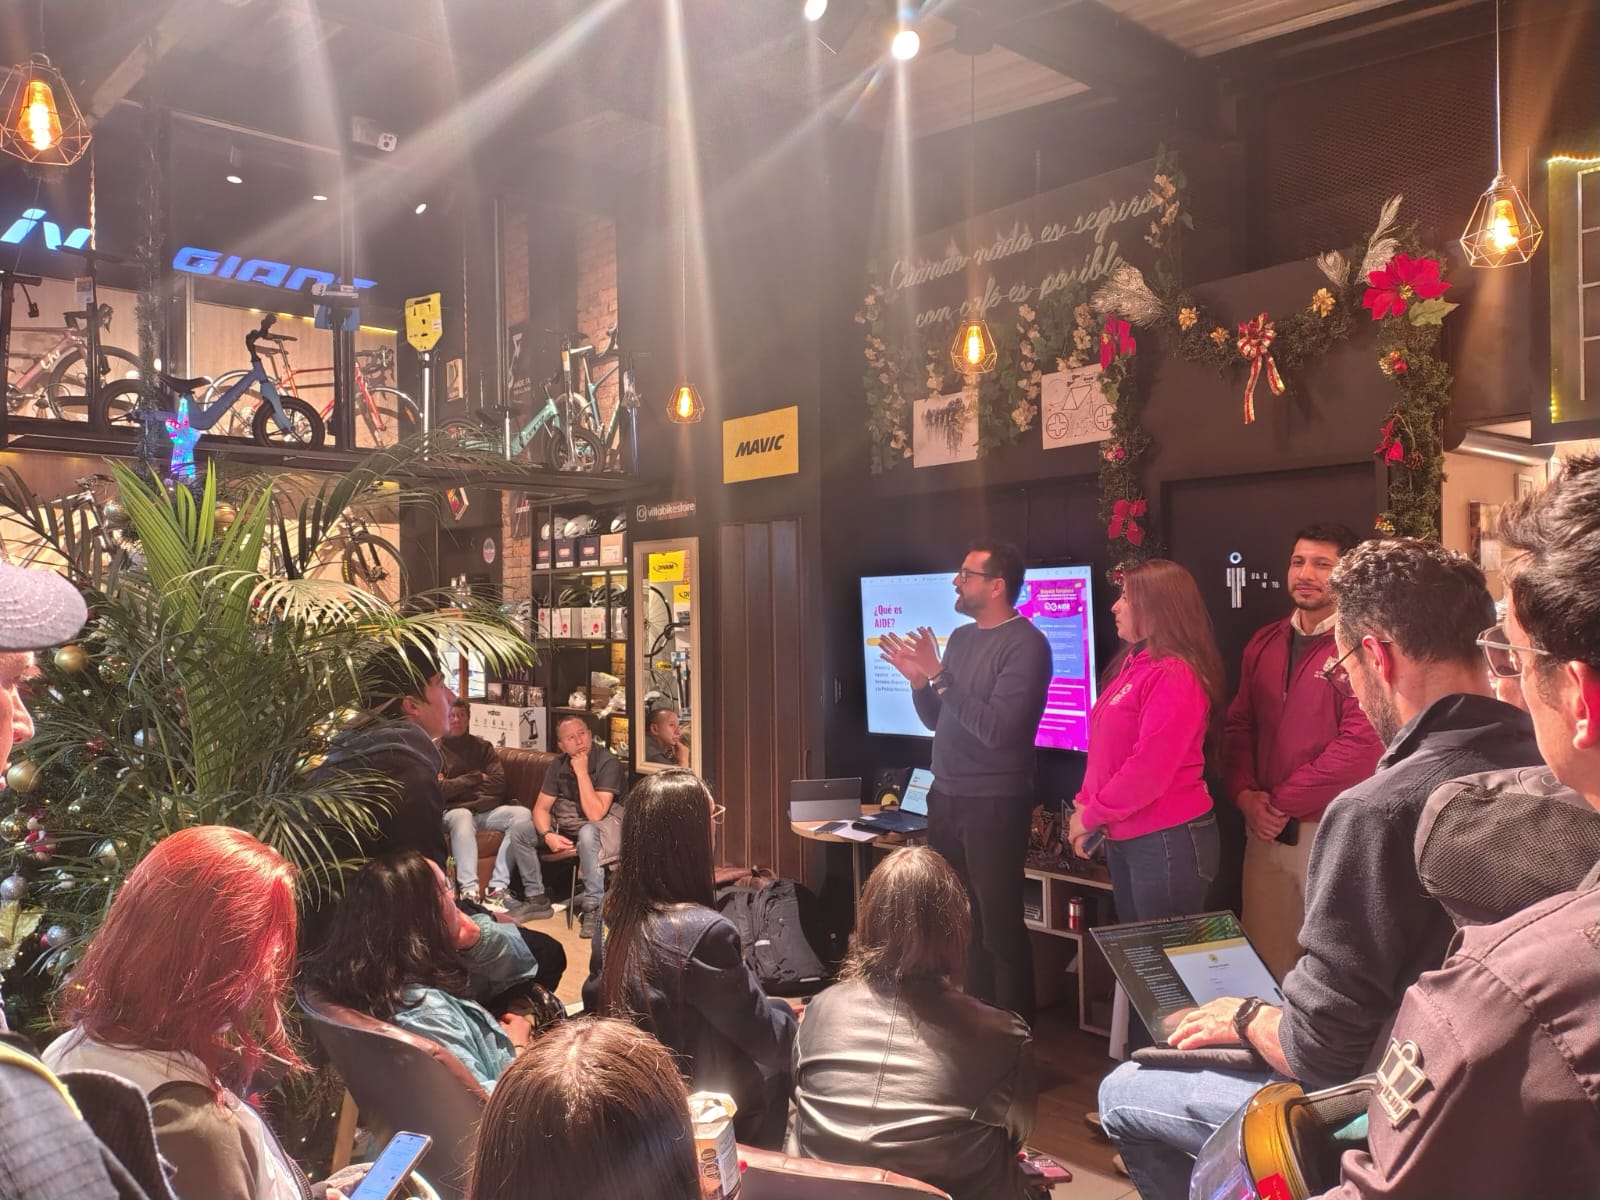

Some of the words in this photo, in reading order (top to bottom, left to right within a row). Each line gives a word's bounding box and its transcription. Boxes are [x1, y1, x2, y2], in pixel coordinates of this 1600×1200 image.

[889, 240, 971, 290] Cuando
[973, 220, 1034, 266] nada
[1041, 223, 1067, 242] es
[915, 305, 952, 328] con
[1008, 283, 1029, 302] es
[735, 434, 785, 458] MAVIC
[874, 604, 892, 616] ¿Qué
[894, 606, 903, 615] es
[874, 618, 896, 628] AIDE?
